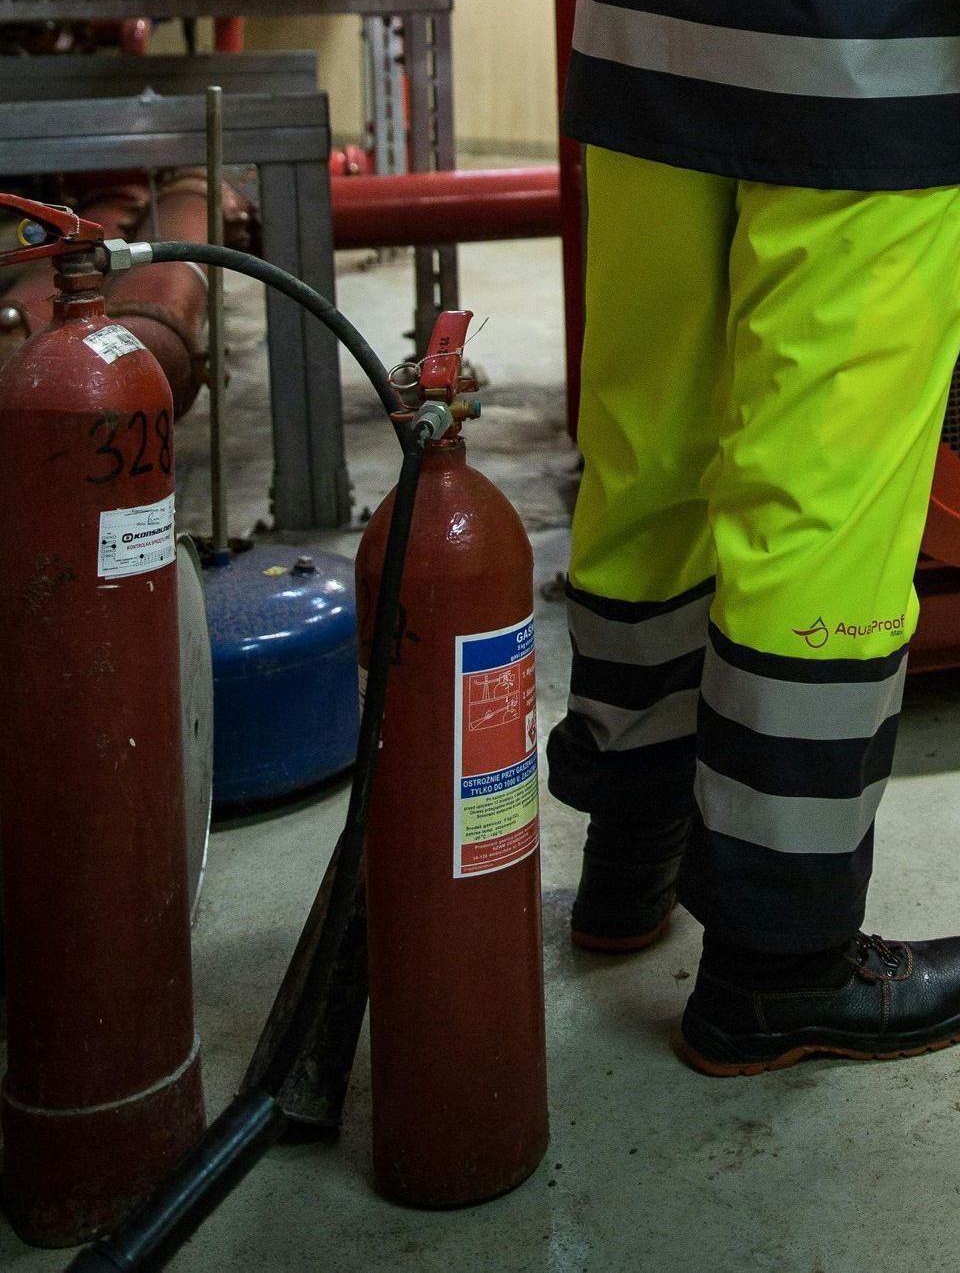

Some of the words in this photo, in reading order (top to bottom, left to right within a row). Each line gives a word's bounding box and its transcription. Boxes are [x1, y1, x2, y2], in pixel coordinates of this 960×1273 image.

[86, 408, 171, 485] 328
[834, 614, 905, 639] AquaProof
[471, 785, 493, 796] TYLKO
[494, 782, 503, 791] DO
